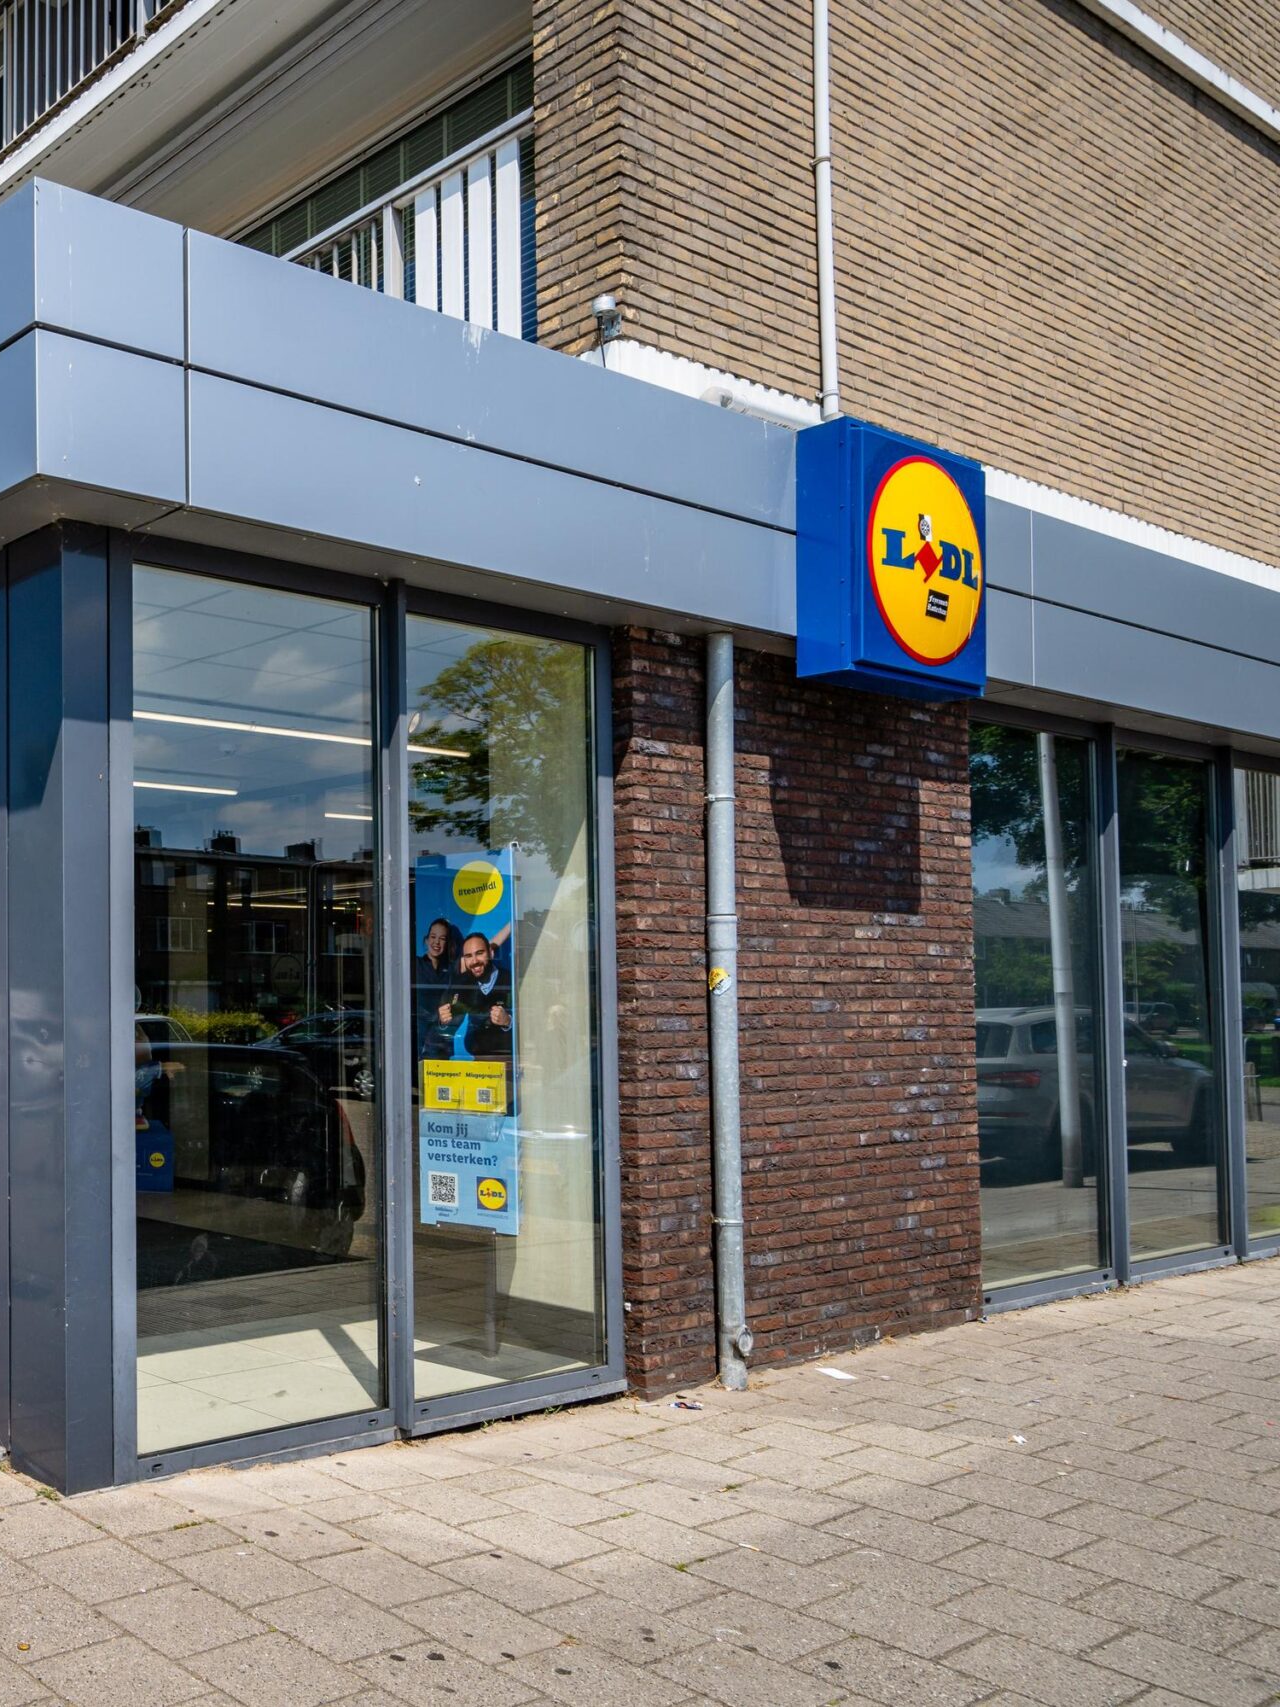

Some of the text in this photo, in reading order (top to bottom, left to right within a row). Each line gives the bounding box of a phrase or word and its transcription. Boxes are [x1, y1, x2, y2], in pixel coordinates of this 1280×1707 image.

[458, 880, 496, 896] #teamlidl
[427, 1121, 469, 1137] Kom jij
[427, 1138, 481, 1151] ons team
[427, 1152, 498, 1166] versterken?
